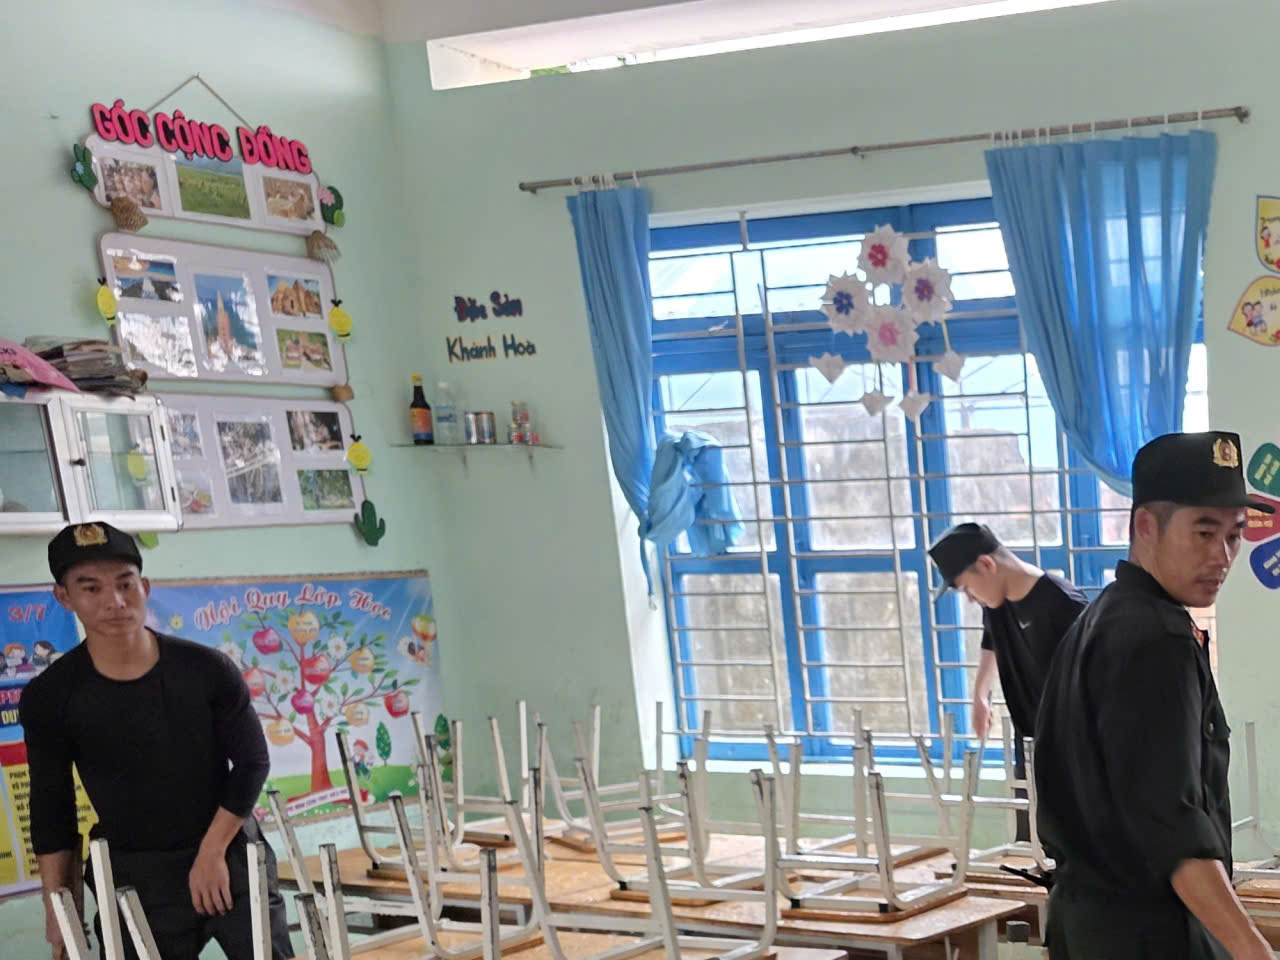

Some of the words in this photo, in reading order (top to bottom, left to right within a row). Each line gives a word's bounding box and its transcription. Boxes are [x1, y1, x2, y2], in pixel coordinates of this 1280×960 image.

[91, 98, 154, 148] GÓC
[446, 335, 497, 364] Khánh
[8, 604, 47, 624] 3/7
[194, 597, 241, 631] Nội
[245, 587, 291, 613] Quy
[294, 583, 342, 609] Lớp
[349, 588, 392, 620] Học
